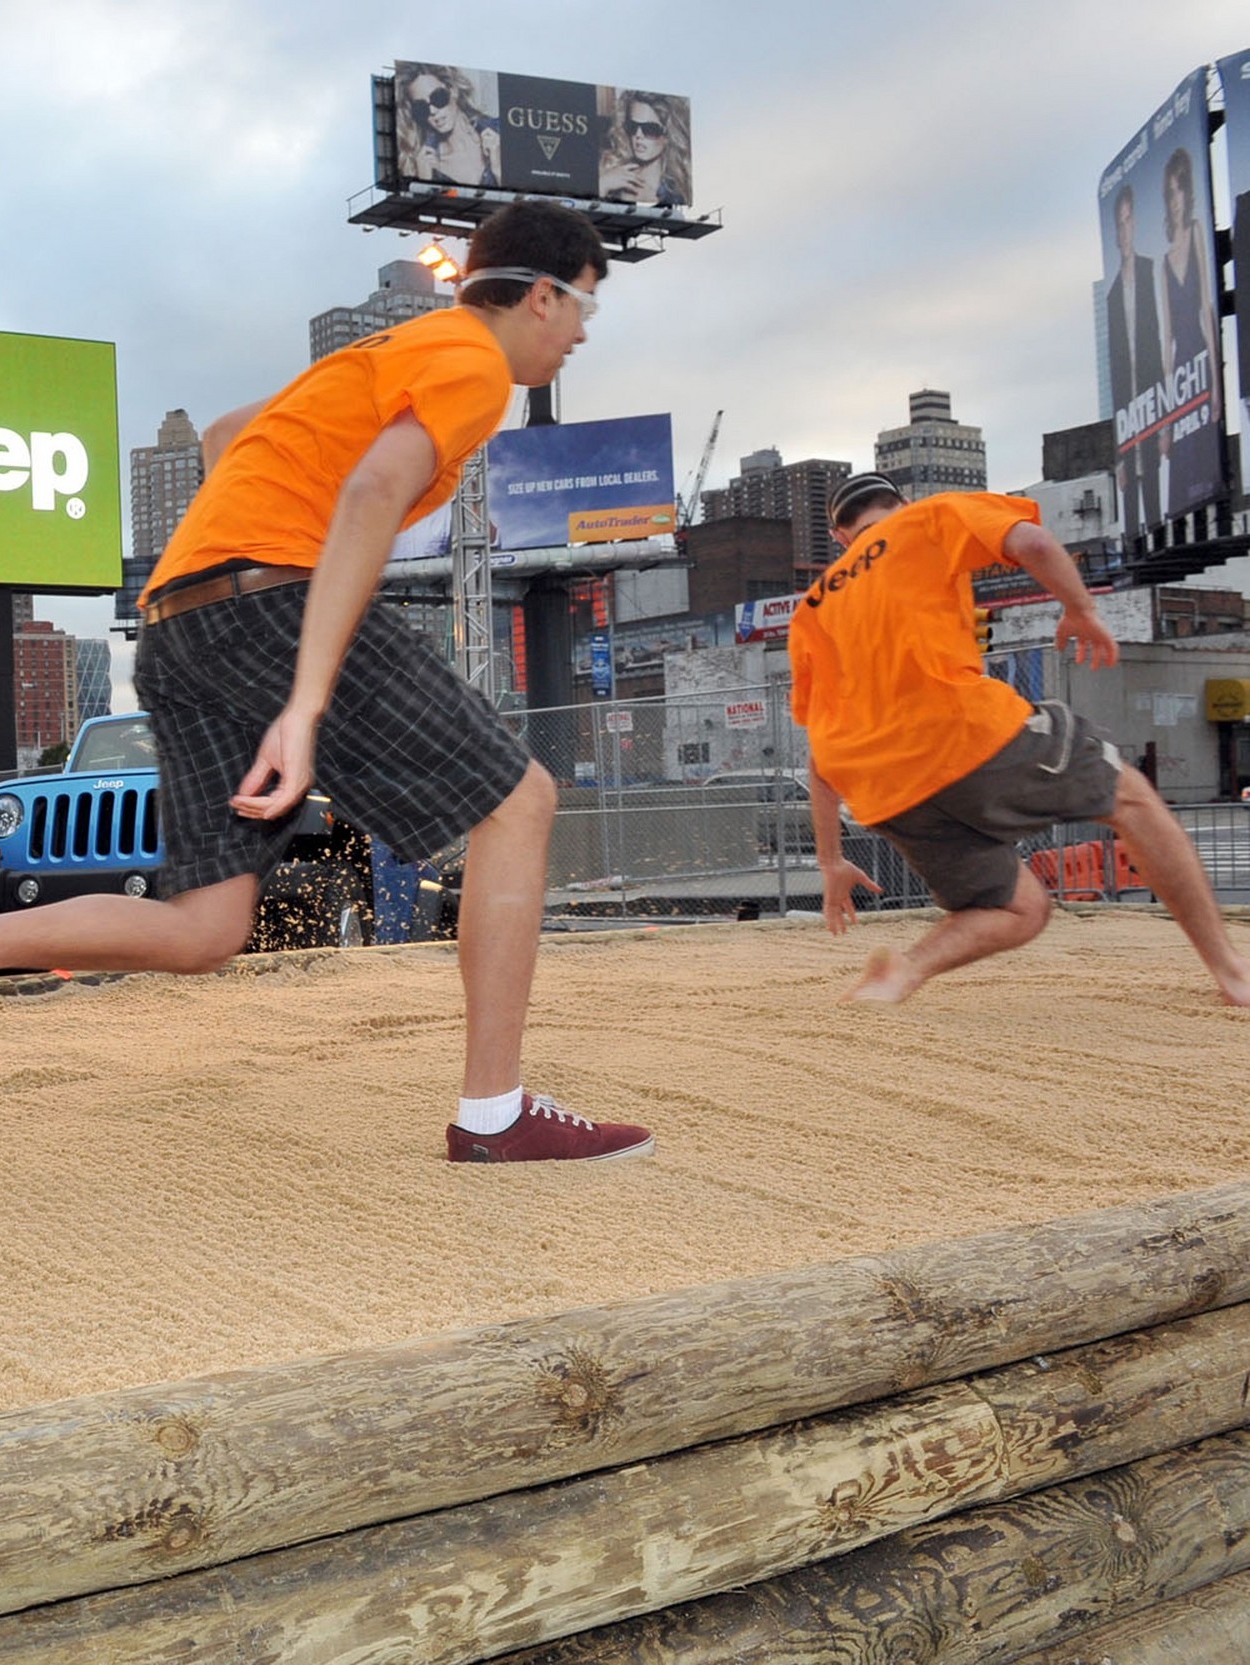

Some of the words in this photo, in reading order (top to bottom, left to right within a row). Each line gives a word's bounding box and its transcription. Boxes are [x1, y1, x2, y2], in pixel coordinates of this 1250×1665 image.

[507, 106, 588, 135] GUESS
[1116, 386, 1156, 446] DATE
[1156, 350, 1209, 418] NIGHT
[1173, 412, 1201, 442] APRIL
[1200, 404, 1210, 426] 9
[508, 482, 524, 495] SIZE
[525, 481, 536, 493] UP
[536, 480, 552, 492] NEW
[554, 478, 573, 491] CARS
[575, 476, 598, 489] FROM
[599, 474, 622, 487] LOCAL
[576, 515, 650, 530] AutoTrader
[763, 600, 791, 617] ACTIVE
[726, 701, 764, 716] NATIONAL
[93, 779, 124, 790] Jeep
